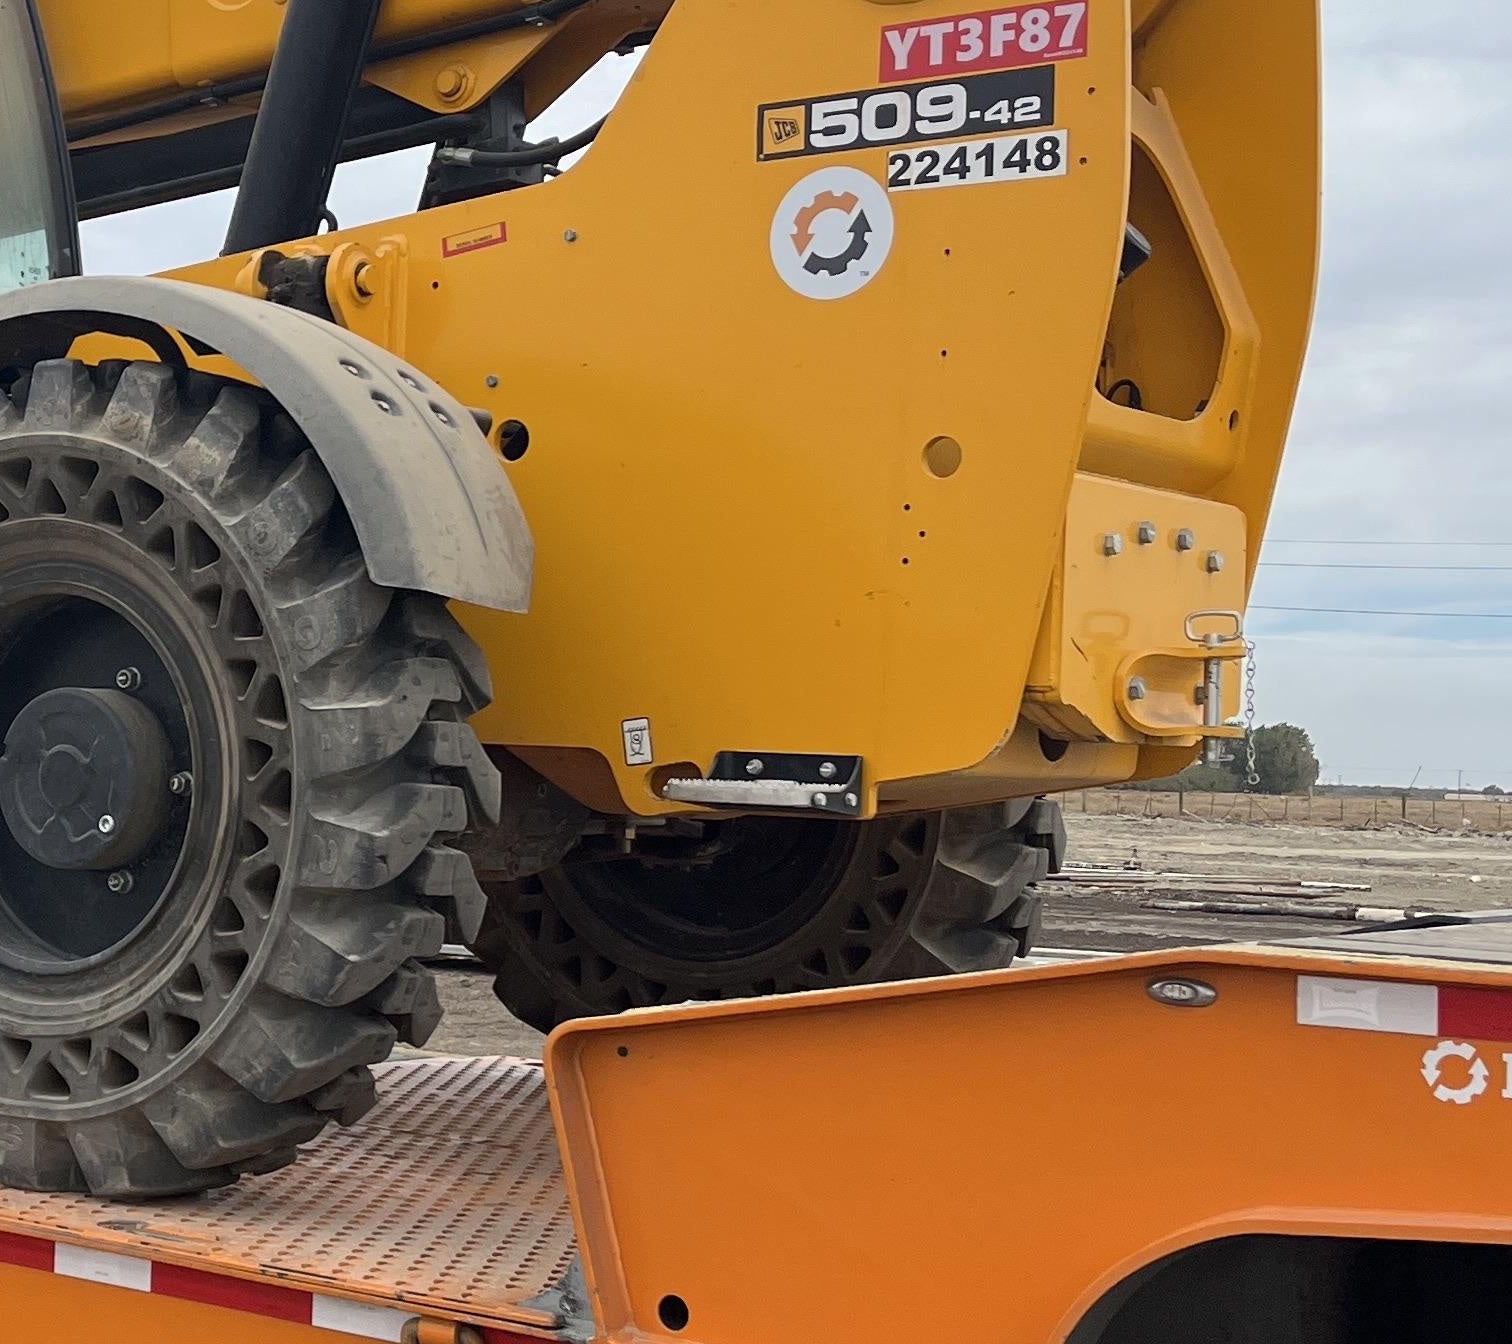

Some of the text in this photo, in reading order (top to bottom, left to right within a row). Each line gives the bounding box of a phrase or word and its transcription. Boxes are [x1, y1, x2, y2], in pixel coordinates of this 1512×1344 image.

[884, 2, 1086, 71] YT3F87
[774, 83, 1041, 148] JCB 509-42
[888, 135, 1061, 188] 224148
